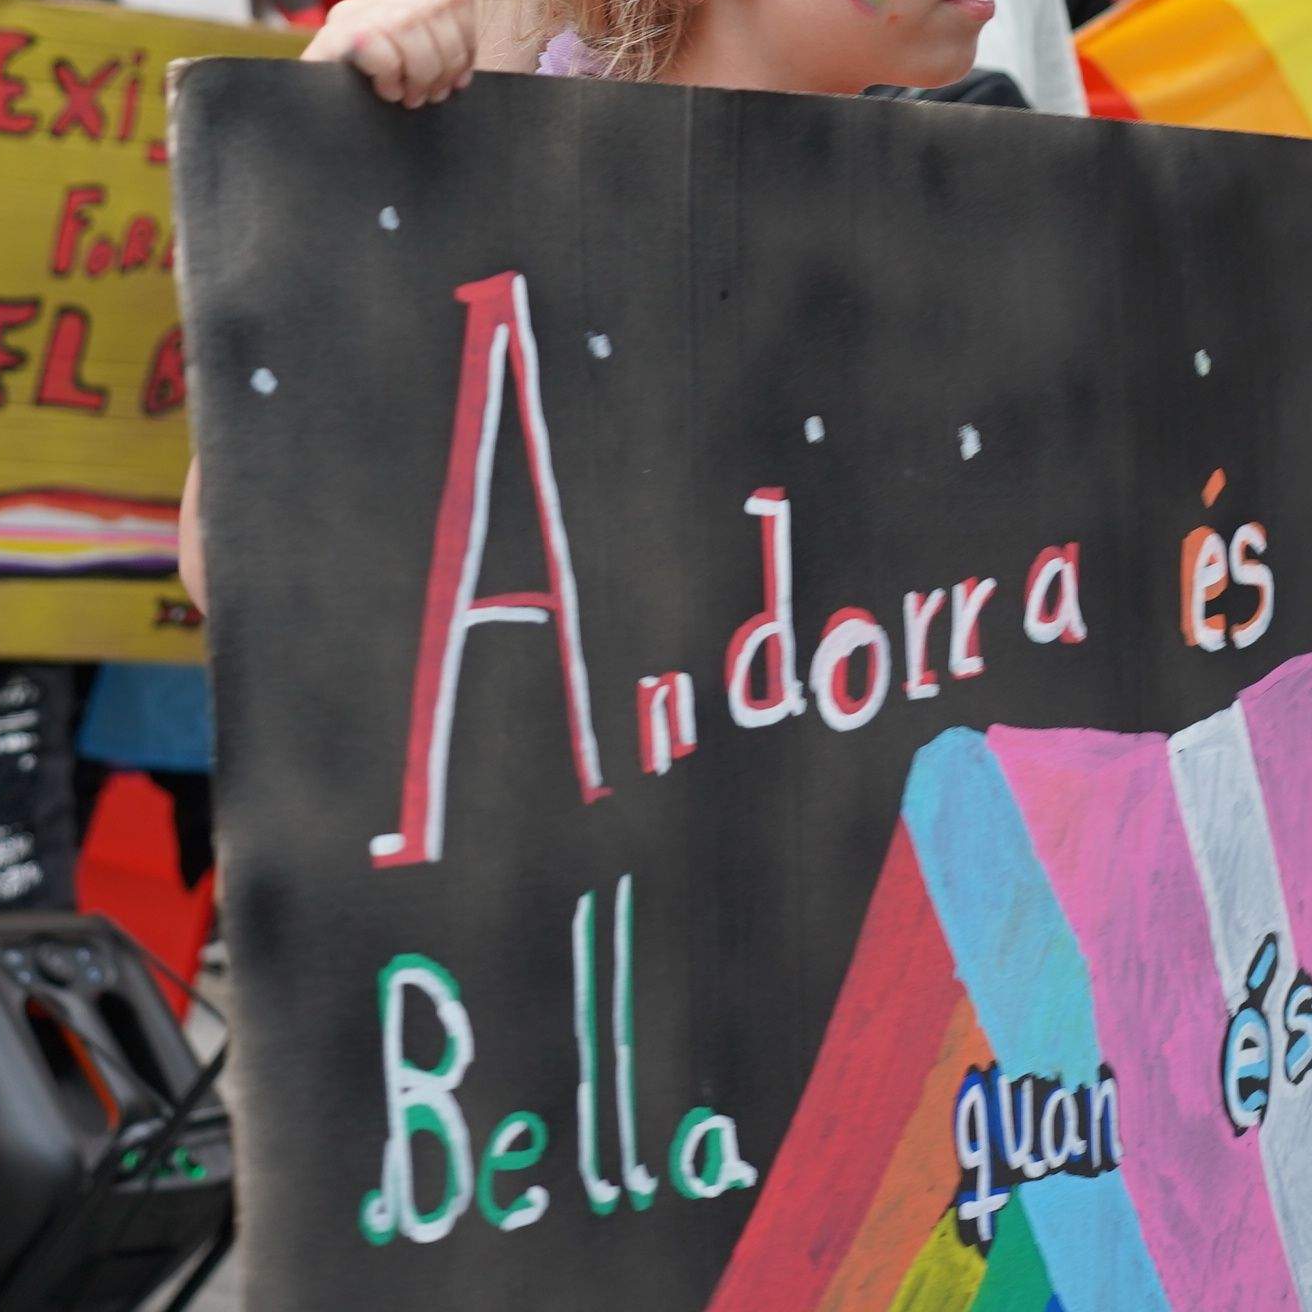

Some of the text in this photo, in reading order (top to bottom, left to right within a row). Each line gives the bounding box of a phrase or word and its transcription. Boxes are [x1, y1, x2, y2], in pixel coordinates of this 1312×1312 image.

[370, 270, 1088, 868] Andorra
[1180, 468, 1276, 652] és
[360, 874, 758, 1244] Bella
[952, 1060, 1124, 1254] quan
